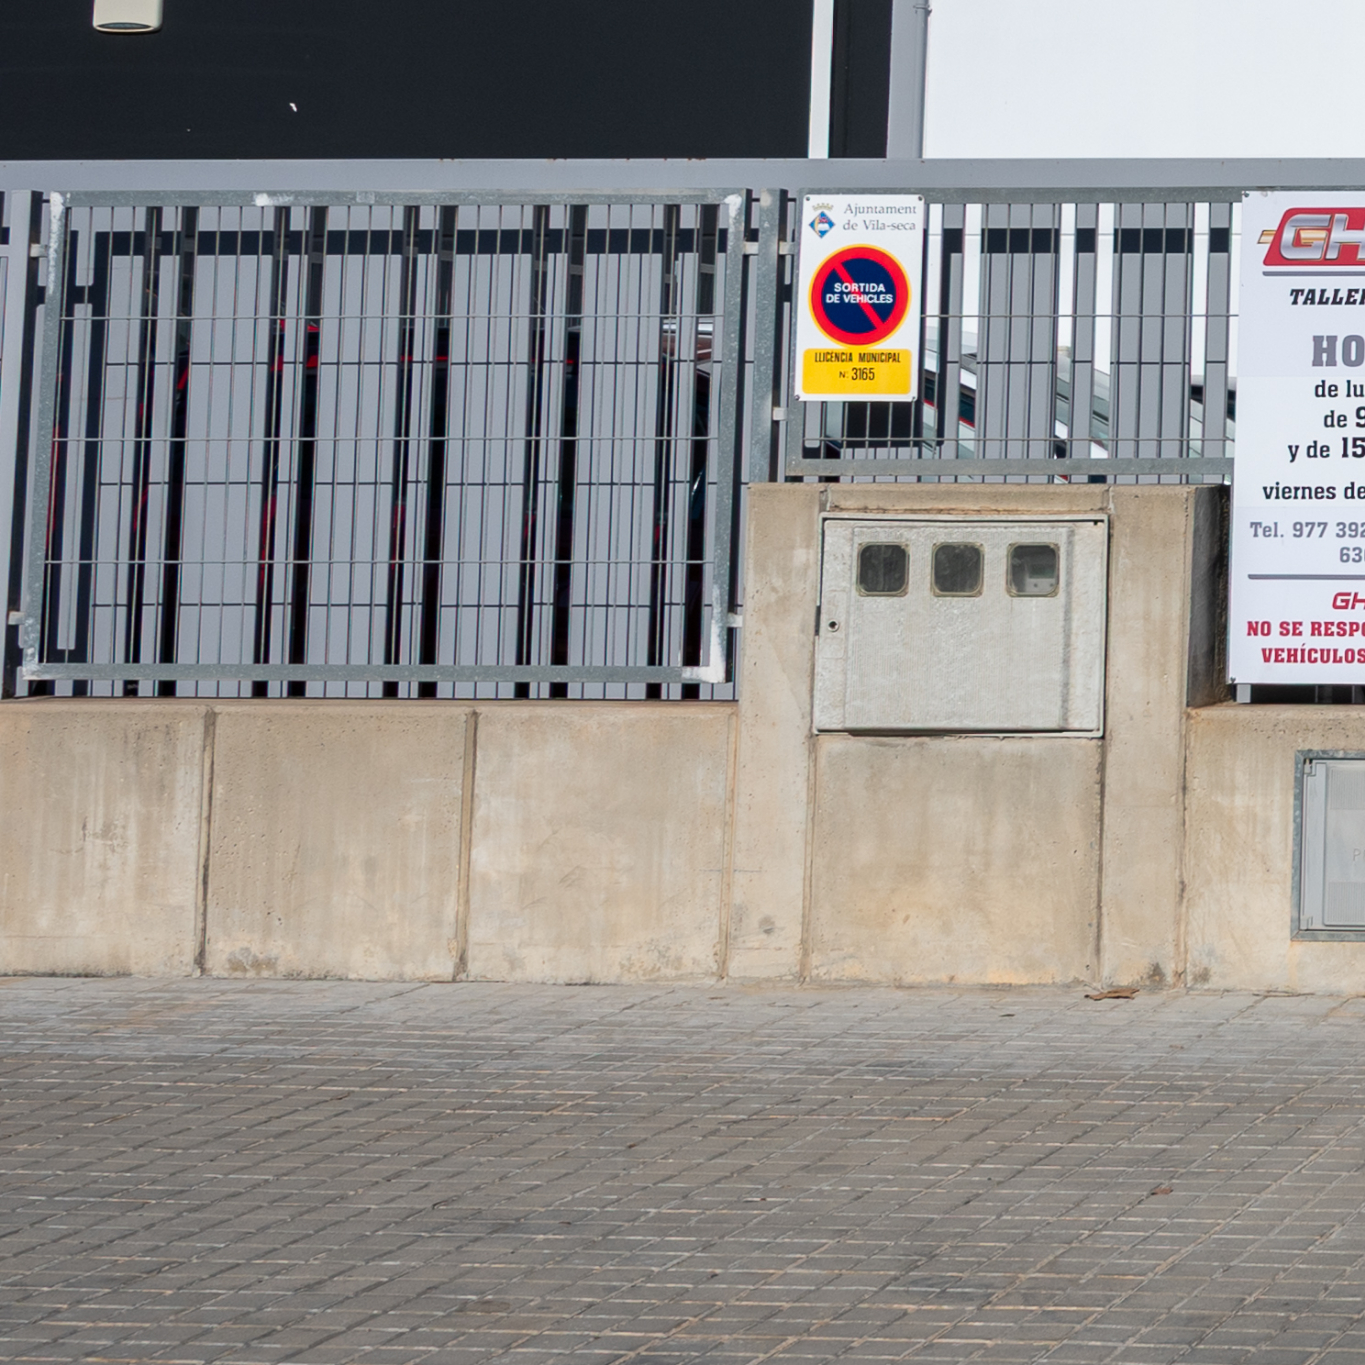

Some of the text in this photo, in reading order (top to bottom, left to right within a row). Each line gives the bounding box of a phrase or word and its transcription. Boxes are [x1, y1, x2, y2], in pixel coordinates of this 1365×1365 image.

[843, 203, 917, 217] Ajuntament
[842, 219, 916, 231] de Vila-seca
[834, 282, 886, 293] SORTIDA
[825, 293, 894, 304] DE VEHICLES
[858, 352, 901, 363] MUNICIPAL
[851, 367, 875, 381] 3165
[1314, 380, 1338, 398] de
[1323, 410, 1347, 428] de
[1287, 444, 1300, 463] y
[1306, 440, 1331, 459] de
[1262, 482, 1337, 500] viernes
[1250, 521, 1284, 538] Tel.
[1293, 521, 1328, 538] 977
[1246, 620, 1272, 637] NO
[1279, 621, 1303, 637] SE
